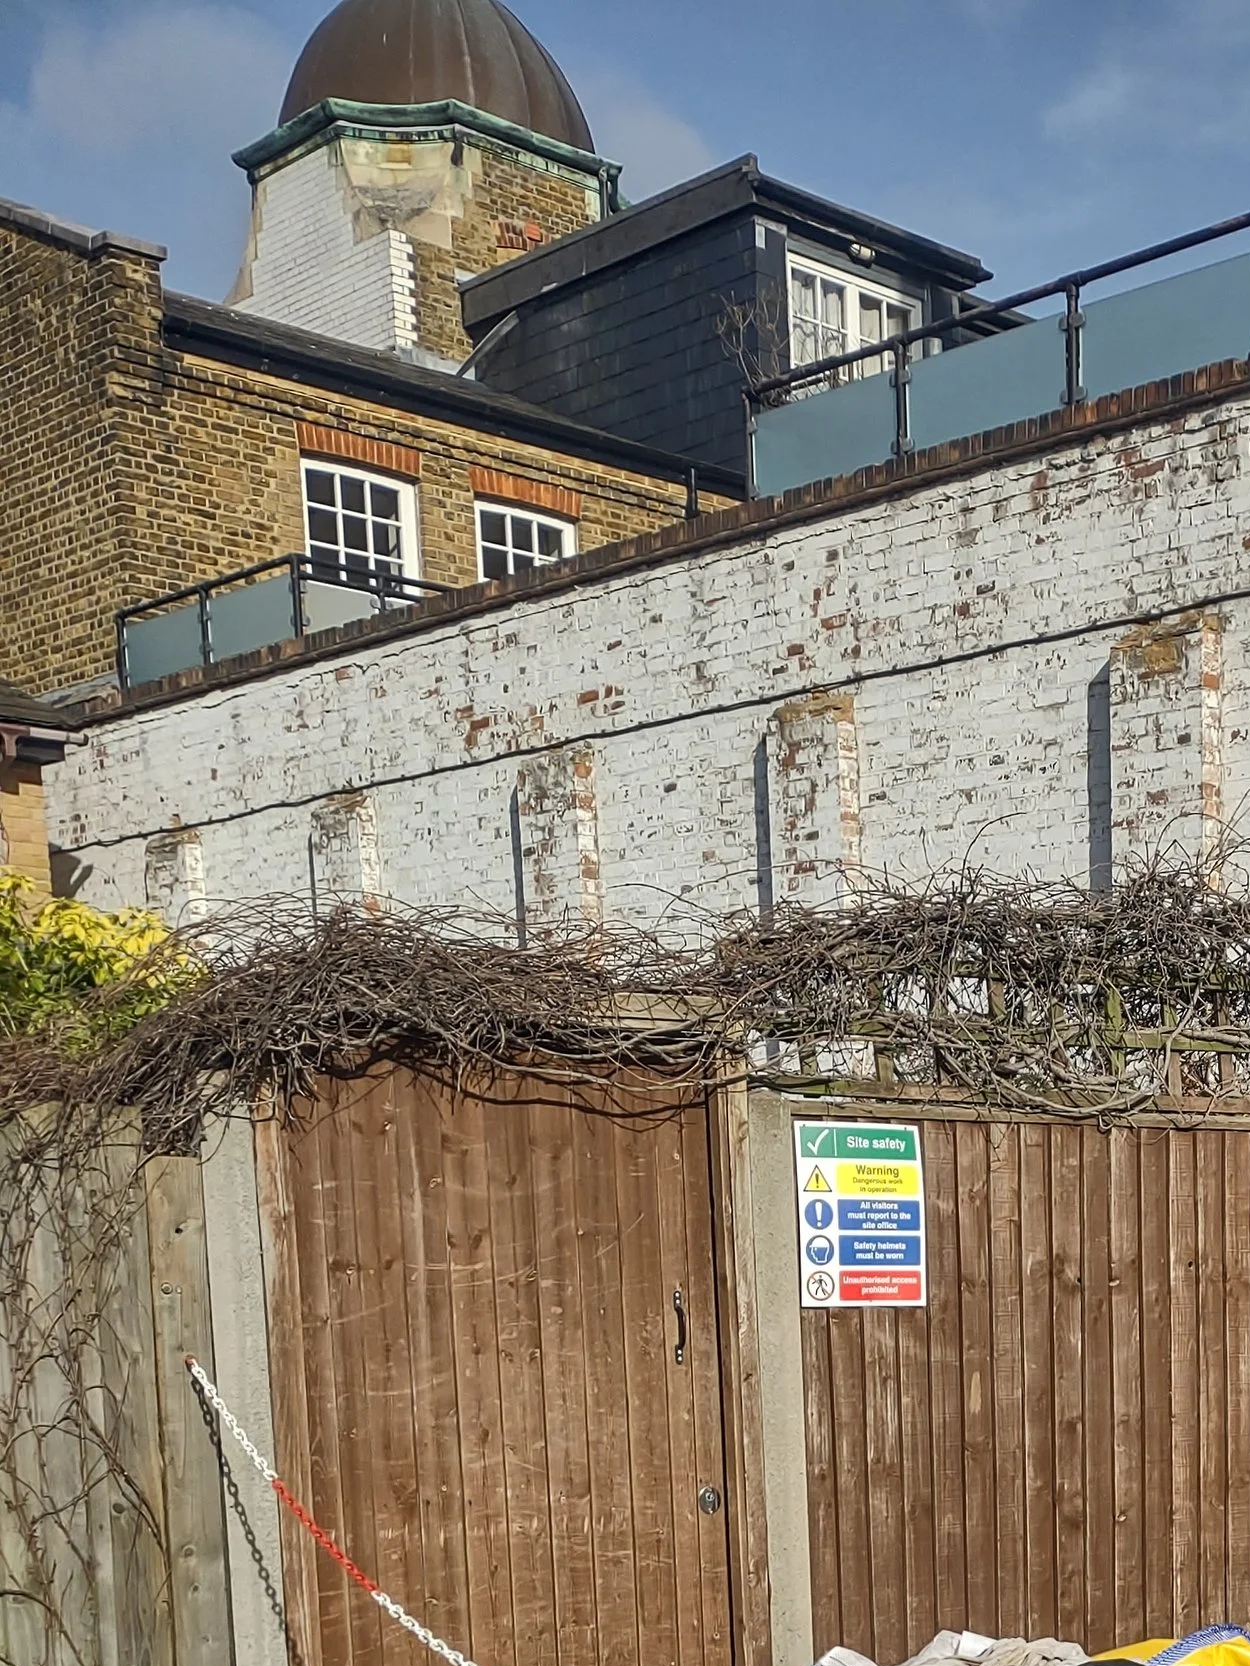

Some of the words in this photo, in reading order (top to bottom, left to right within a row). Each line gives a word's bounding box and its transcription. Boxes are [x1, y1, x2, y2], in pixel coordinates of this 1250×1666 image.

[846, 1135, 869, 1148] Site
[872, 1137, 906, 1153] safety
[855, 1164, 899, 1178] Warning
[852, 1176, 887, 1185] Dangerous
[860, 1201, 871, 1209] All
[872, 1202, 898, 1210] visitors
[867, 1212, 889, 1220] report
[853, 1241, 876, 1251] Safety
[877, 1241, 906, 1250] helmets
[842, 1275, 890, 1284] Unauthorised
[861, 1285, 898, 1296] prohibited
